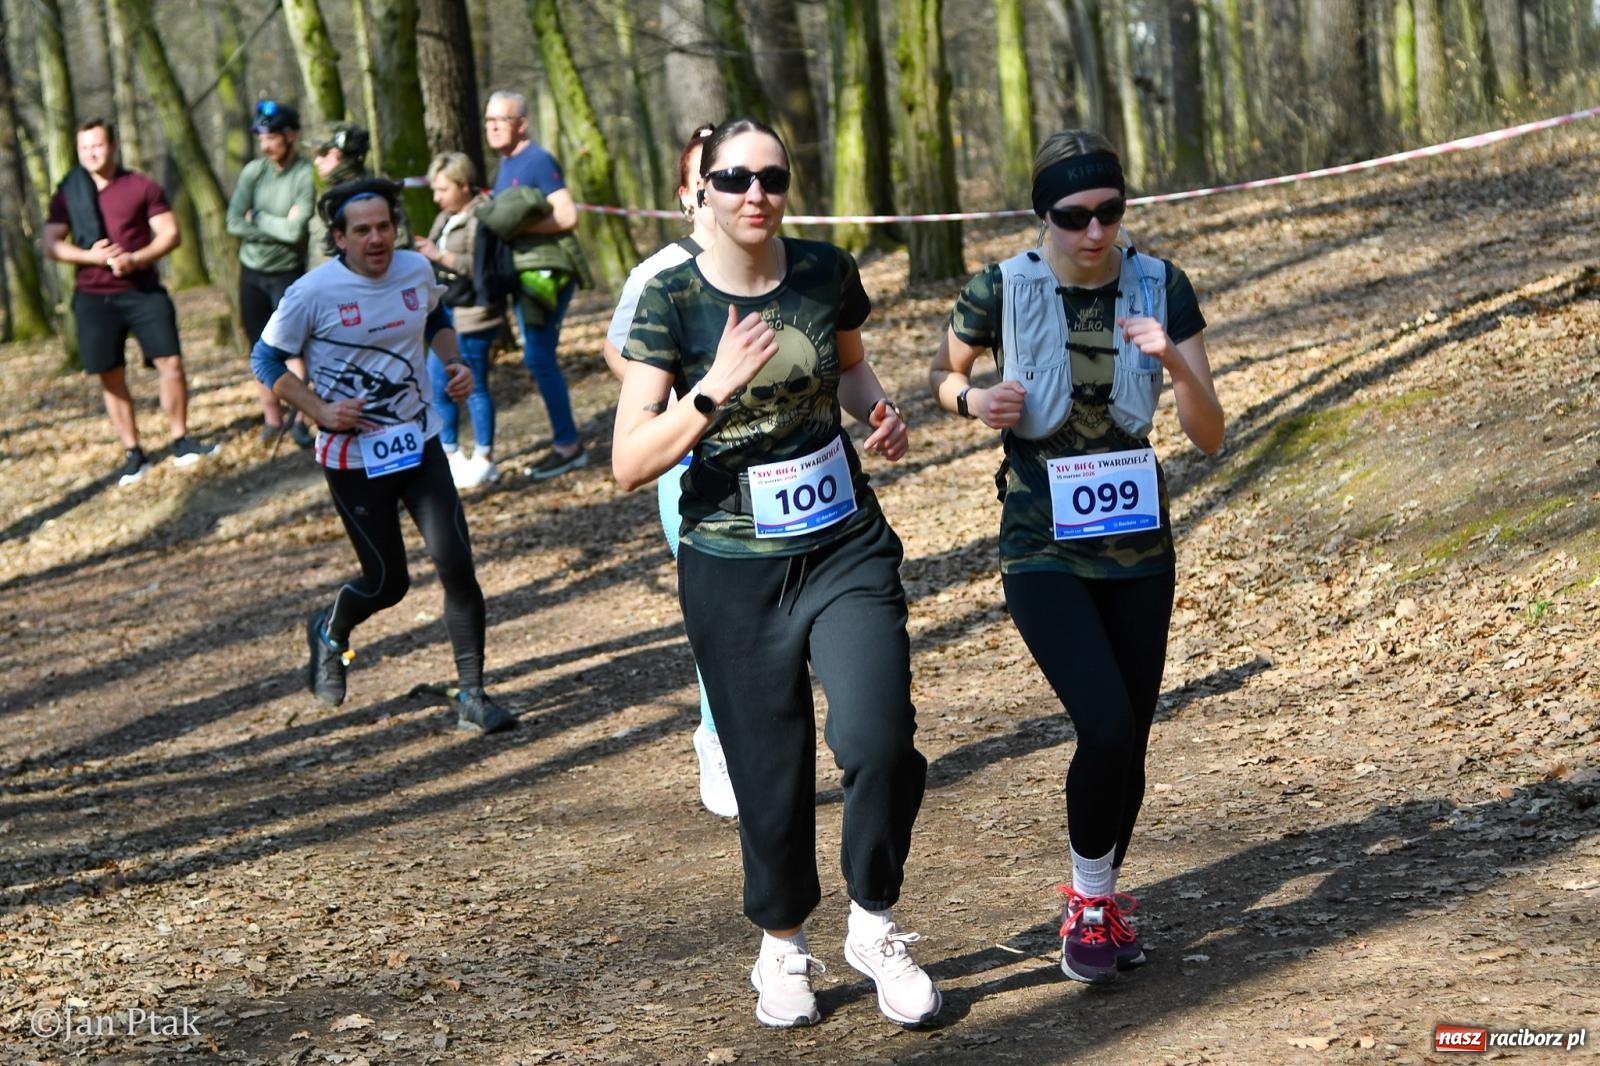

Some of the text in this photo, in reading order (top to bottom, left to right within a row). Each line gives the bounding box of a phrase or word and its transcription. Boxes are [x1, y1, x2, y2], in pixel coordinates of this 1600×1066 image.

[1074, 320, 1103, 331] HERO
[373, 432, 417, 459] 048
[1056, 463, 1071, 473] XIV
[1074, 462, 1095, 471] BIEG
[775, 475, 837, 516] 100
[1072, 480, 1139, 515] 099
